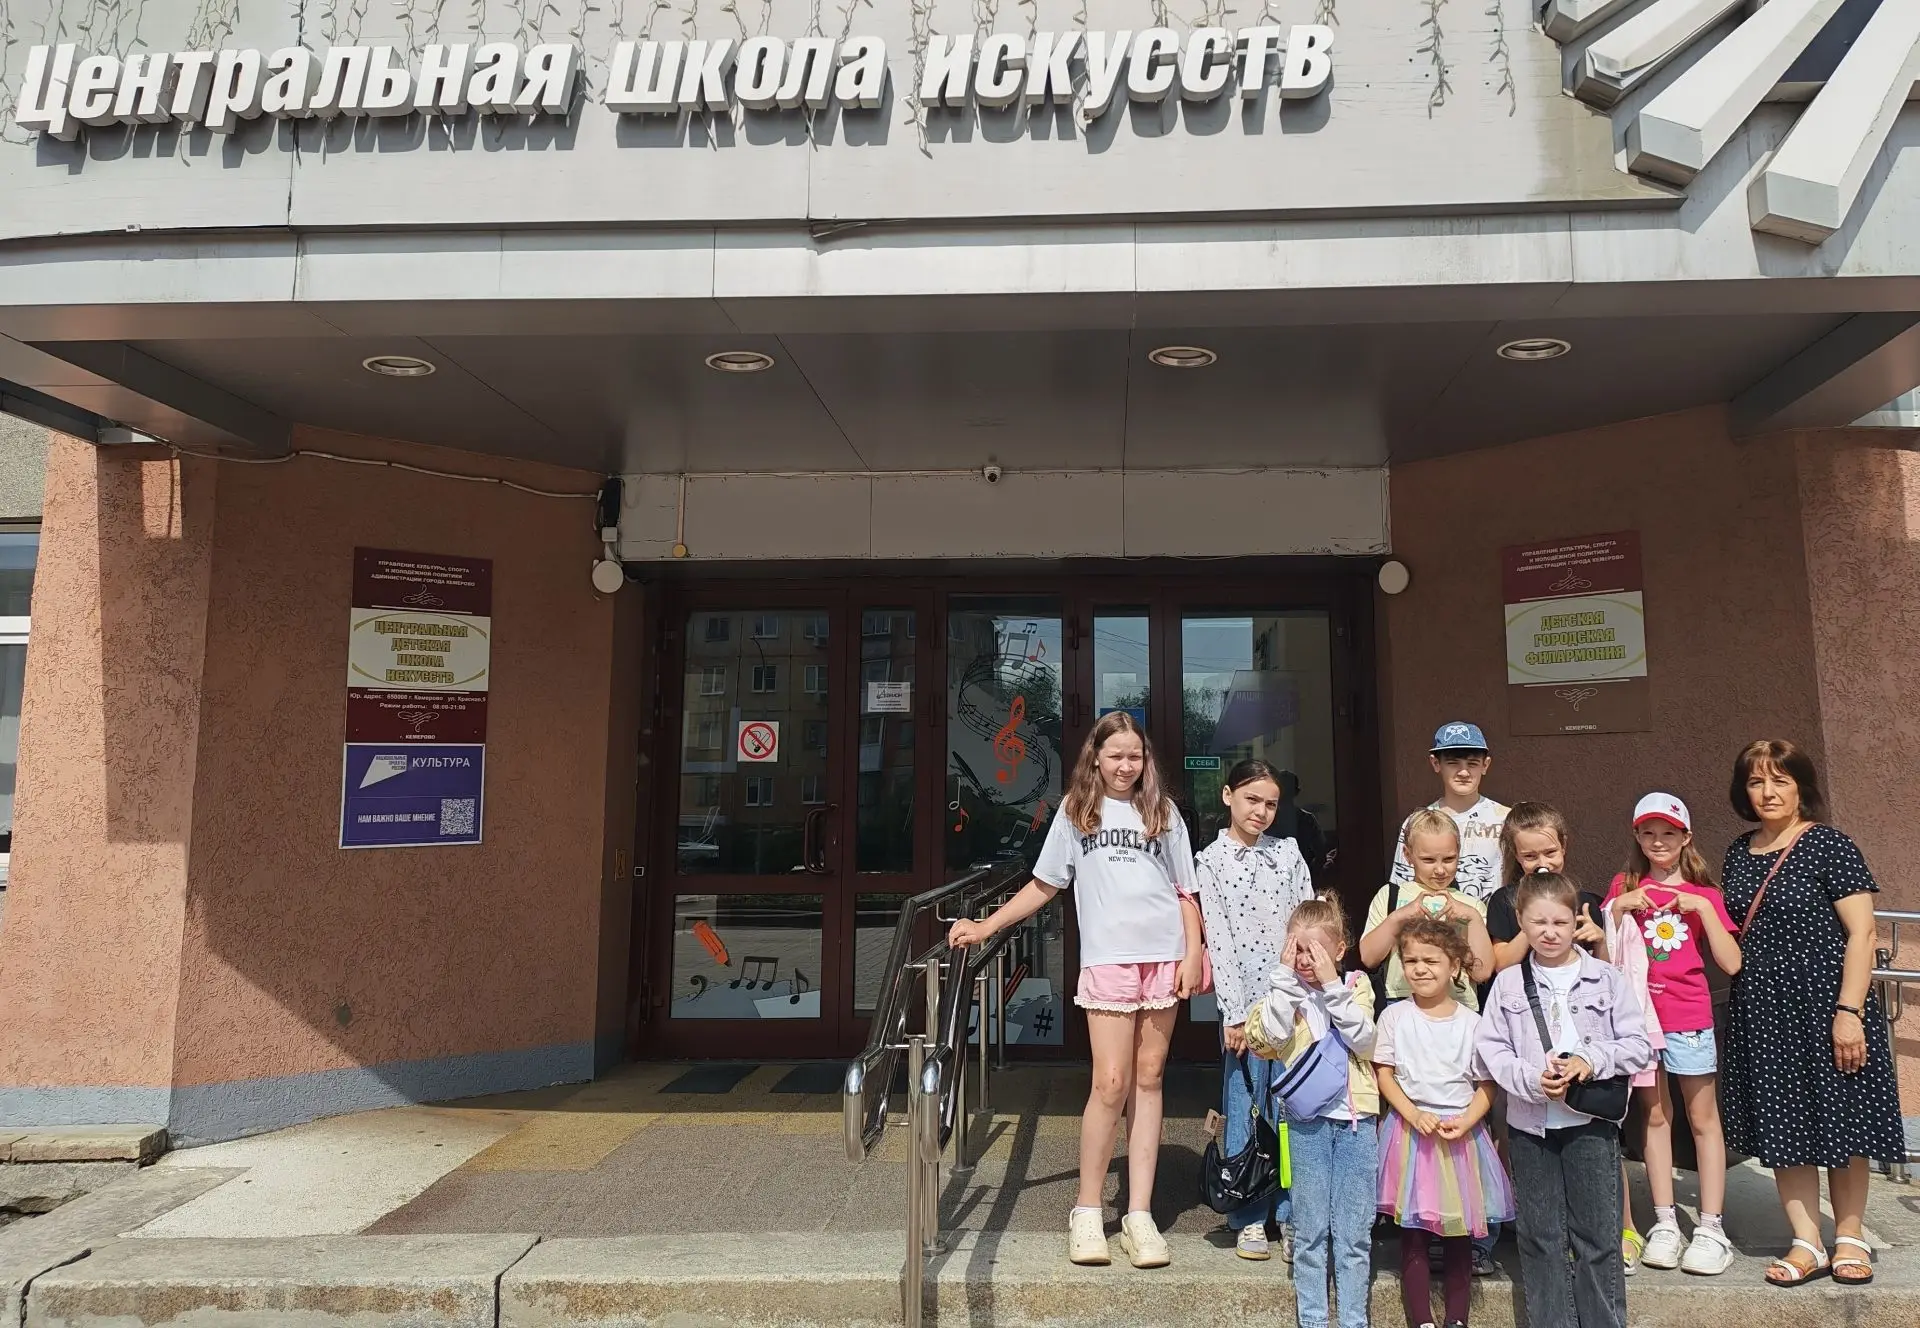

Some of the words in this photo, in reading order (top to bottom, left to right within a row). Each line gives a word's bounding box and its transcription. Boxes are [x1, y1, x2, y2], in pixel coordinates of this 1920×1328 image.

[15, 43, 579, 141] Центральная
[604, 35, 887, 114] школа
[918, 24, 1335, 119] искусств
[374, 620, 468, 637] ЦЕНТРАЛЬНАЯ
[1541, 611, 1604, 631] ДЕТСКАЯ
[391, 637, 451, 652] ДЕТСКАЯ
[1534, 628, 1615, 647] ГОРОДСКАЯ
[397, 654, 444, 667] ШКОЛА
[1525, 645, 1626, 665] ФИЛАРМОНИЯ
[386, 669, 455, 683] ИСКУССТВ
[412, 757, 471, 768] КУЛЬТУРА
[357, 815, 372, 823] НАМ
[372, 815, 394, 823] ВАЖНО
[412, 813, 436, 821] МНЕНИЕ
